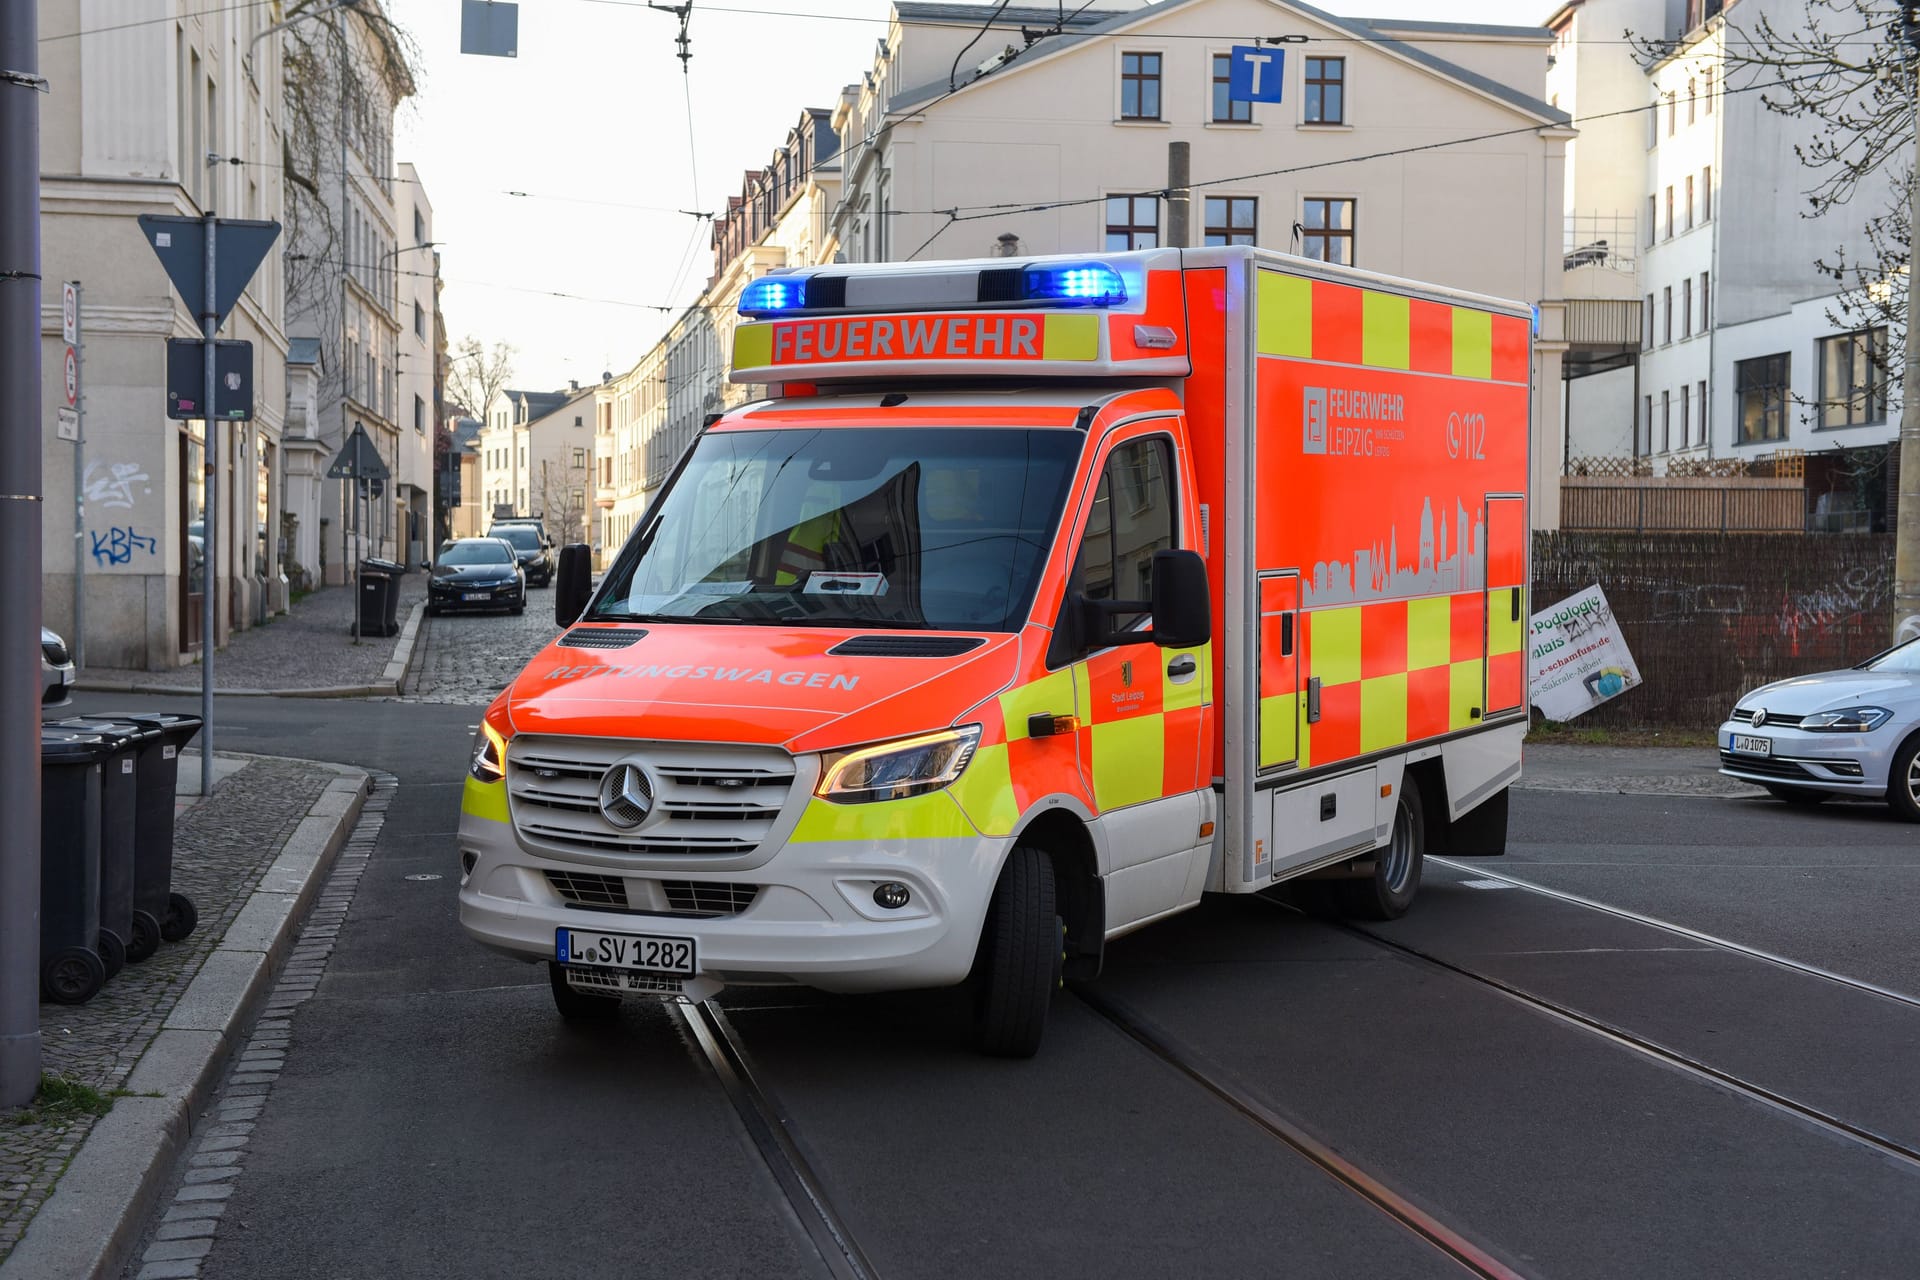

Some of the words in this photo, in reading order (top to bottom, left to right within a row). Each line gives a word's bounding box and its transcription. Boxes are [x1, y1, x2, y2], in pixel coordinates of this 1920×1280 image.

[1243, 53, 1272, 95] T
[774, 317, 1038, 362] FEUERWEHR
[1329, 387, 1405, 422] FEUERWEHR
[1329, 426, 1373, 457] LEIPZIG
[1463, 412, 1486, 460] 112
[1534, 596, 1600, 634] Podologie
[543, 664, 860, 692] RETTUNGSWAGEN
[1750, 738, 1768, 752] 1075
[570, 934, 584, 960] L
[599, 937, 626, 963] SV
[632, 940, 689, 969] 1282
